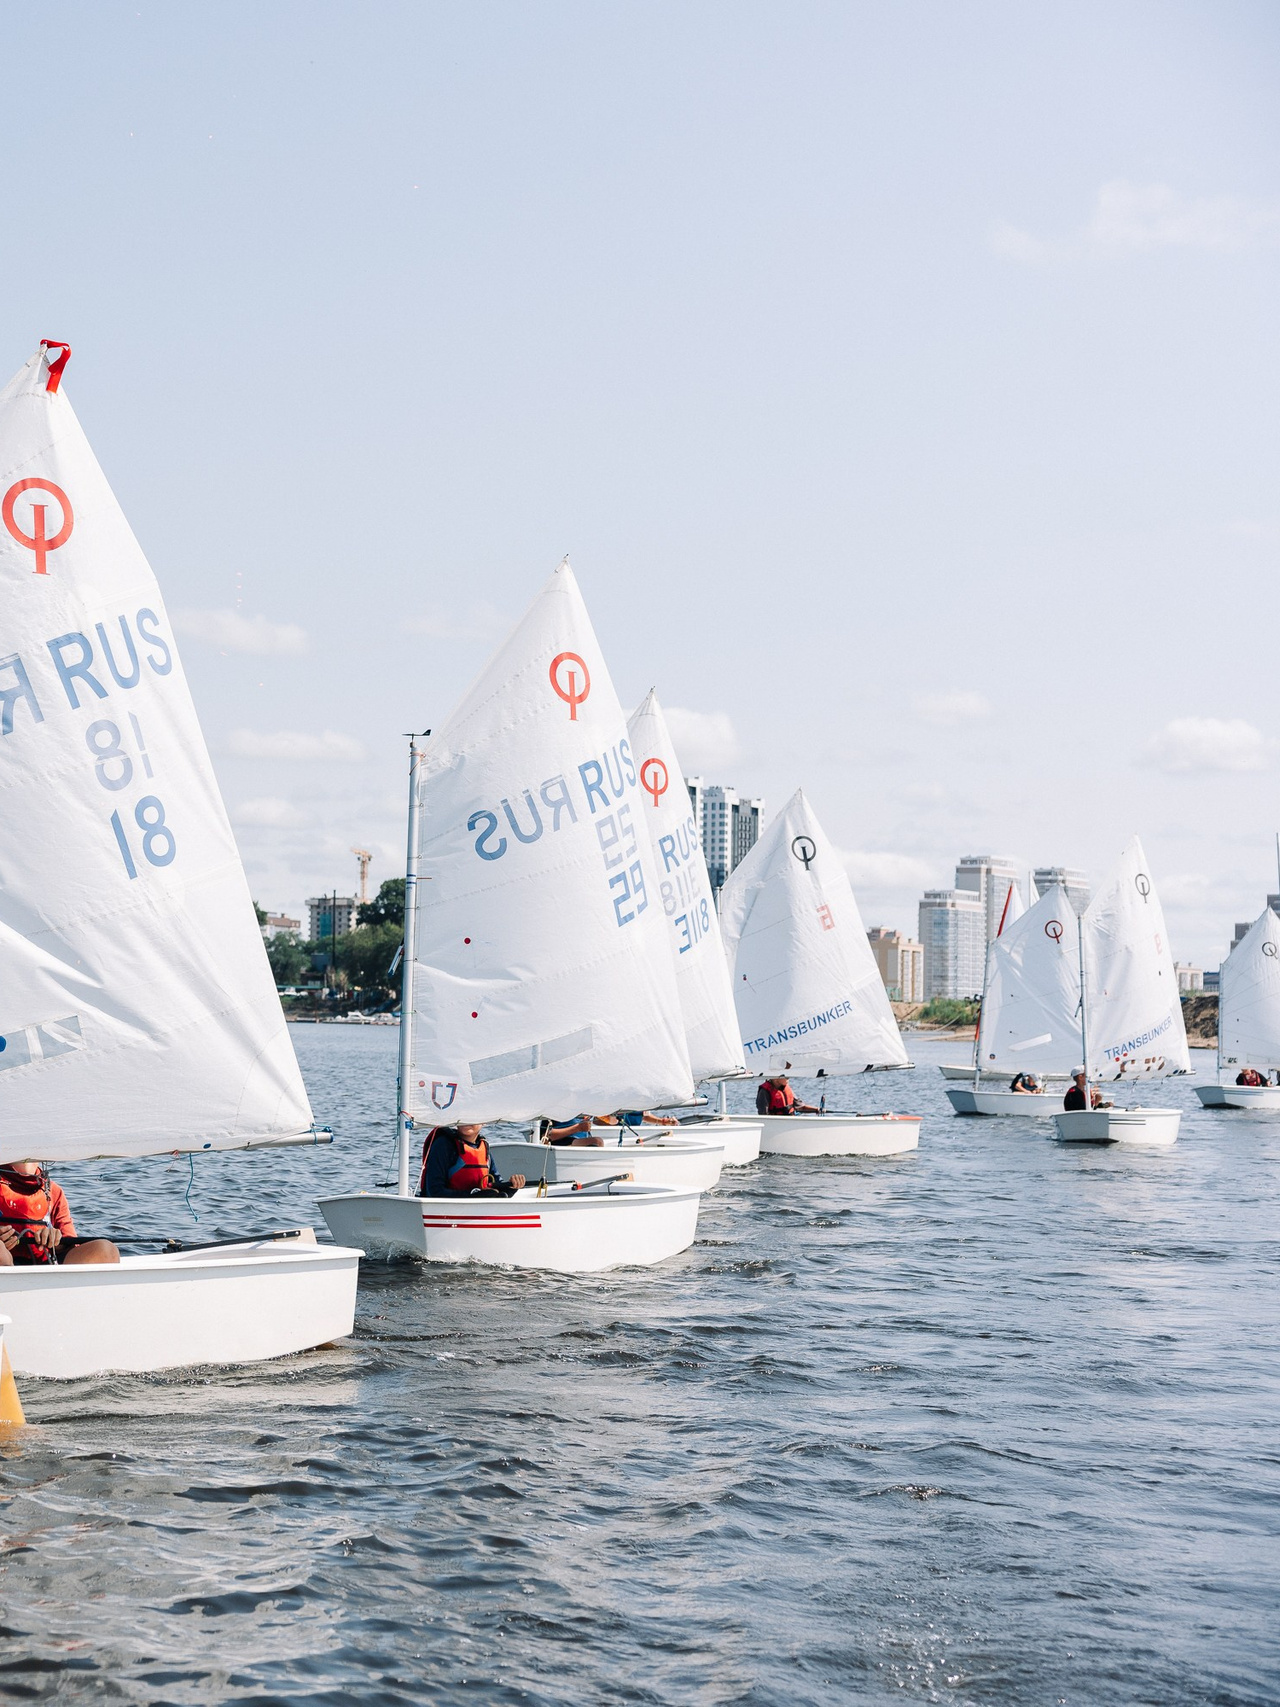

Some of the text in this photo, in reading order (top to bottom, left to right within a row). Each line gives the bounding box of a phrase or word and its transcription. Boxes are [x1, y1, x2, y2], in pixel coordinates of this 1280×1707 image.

[47, 608, 172, 710] RUS
[578, 739, 637, 814] RUS
[110, 795, 176, 880] 18
[658, 817, 698, 873] RUS
[609, 860, 648, 927] 29
[744, 1000, 853, 1054] TRANSBUNKER
[1104, 1016, 1172, 1060] TRANSBUNKER
